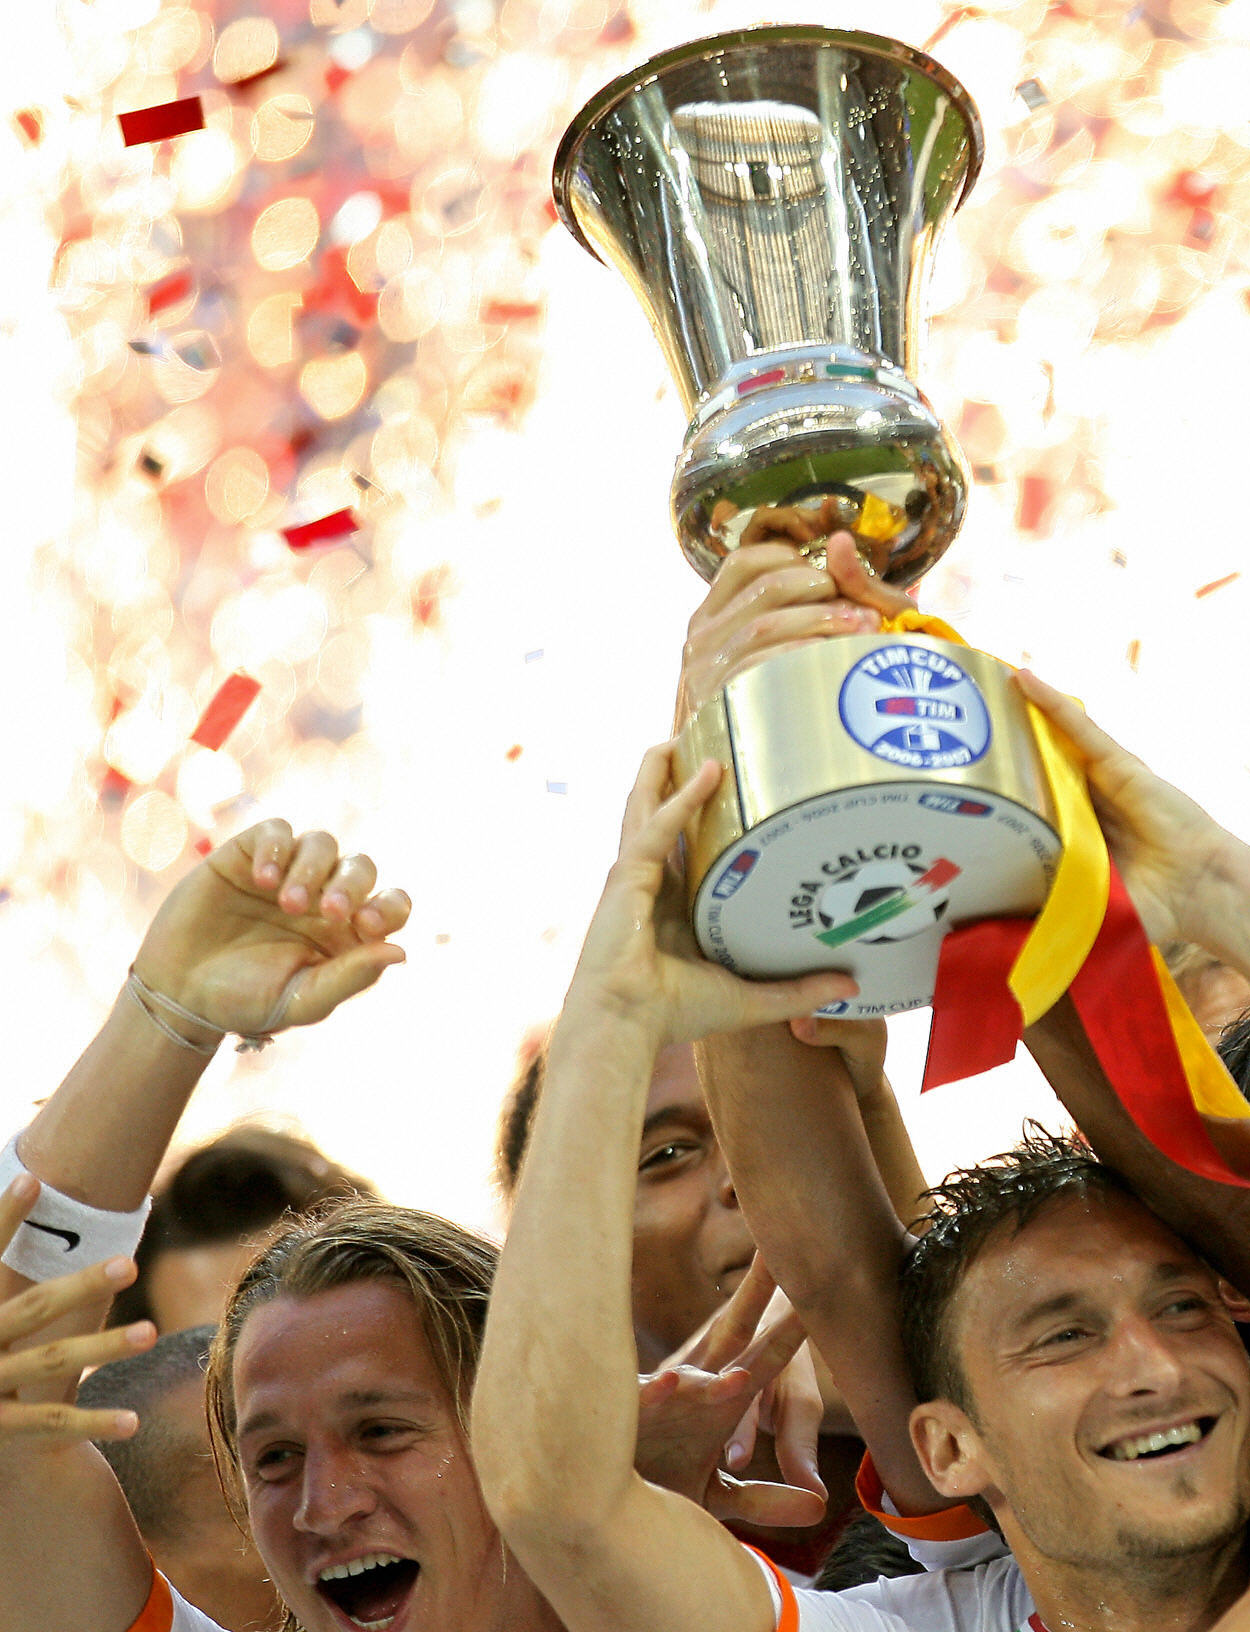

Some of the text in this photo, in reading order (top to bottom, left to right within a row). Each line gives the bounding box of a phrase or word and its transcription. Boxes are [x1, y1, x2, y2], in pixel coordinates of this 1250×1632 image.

[917, 700, 957, 720] TIM
[790, 844, 922, 929] LEGA CALCIO
[857, 1003, 886, 1015] TIM
[889, 998, 923, 1012] CUP
